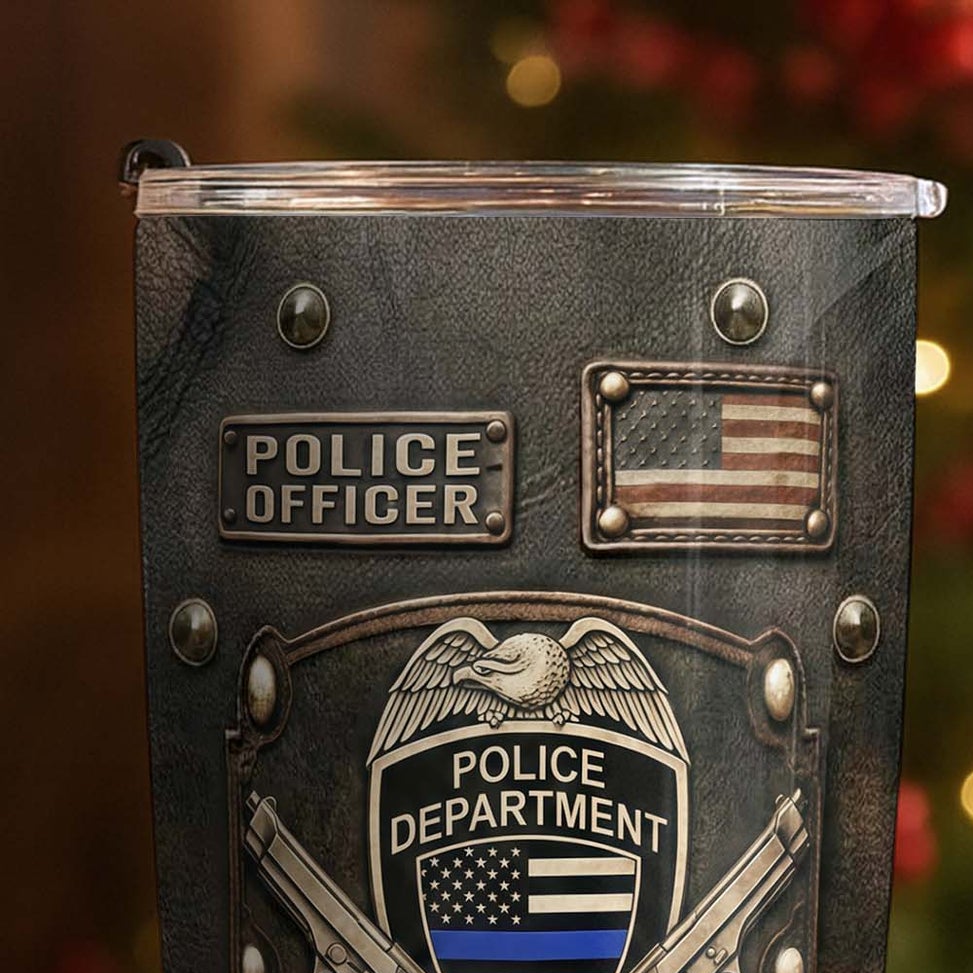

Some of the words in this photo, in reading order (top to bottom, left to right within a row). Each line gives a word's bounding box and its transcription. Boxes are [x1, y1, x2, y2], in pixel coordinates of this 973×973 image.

[246, 433, 481, 476] POLICE
[246, 485, 479, 525] OFFICER
[453, 745, 605, 789] POLICE
[391, 790, 668, 856] DEPARTMENT
